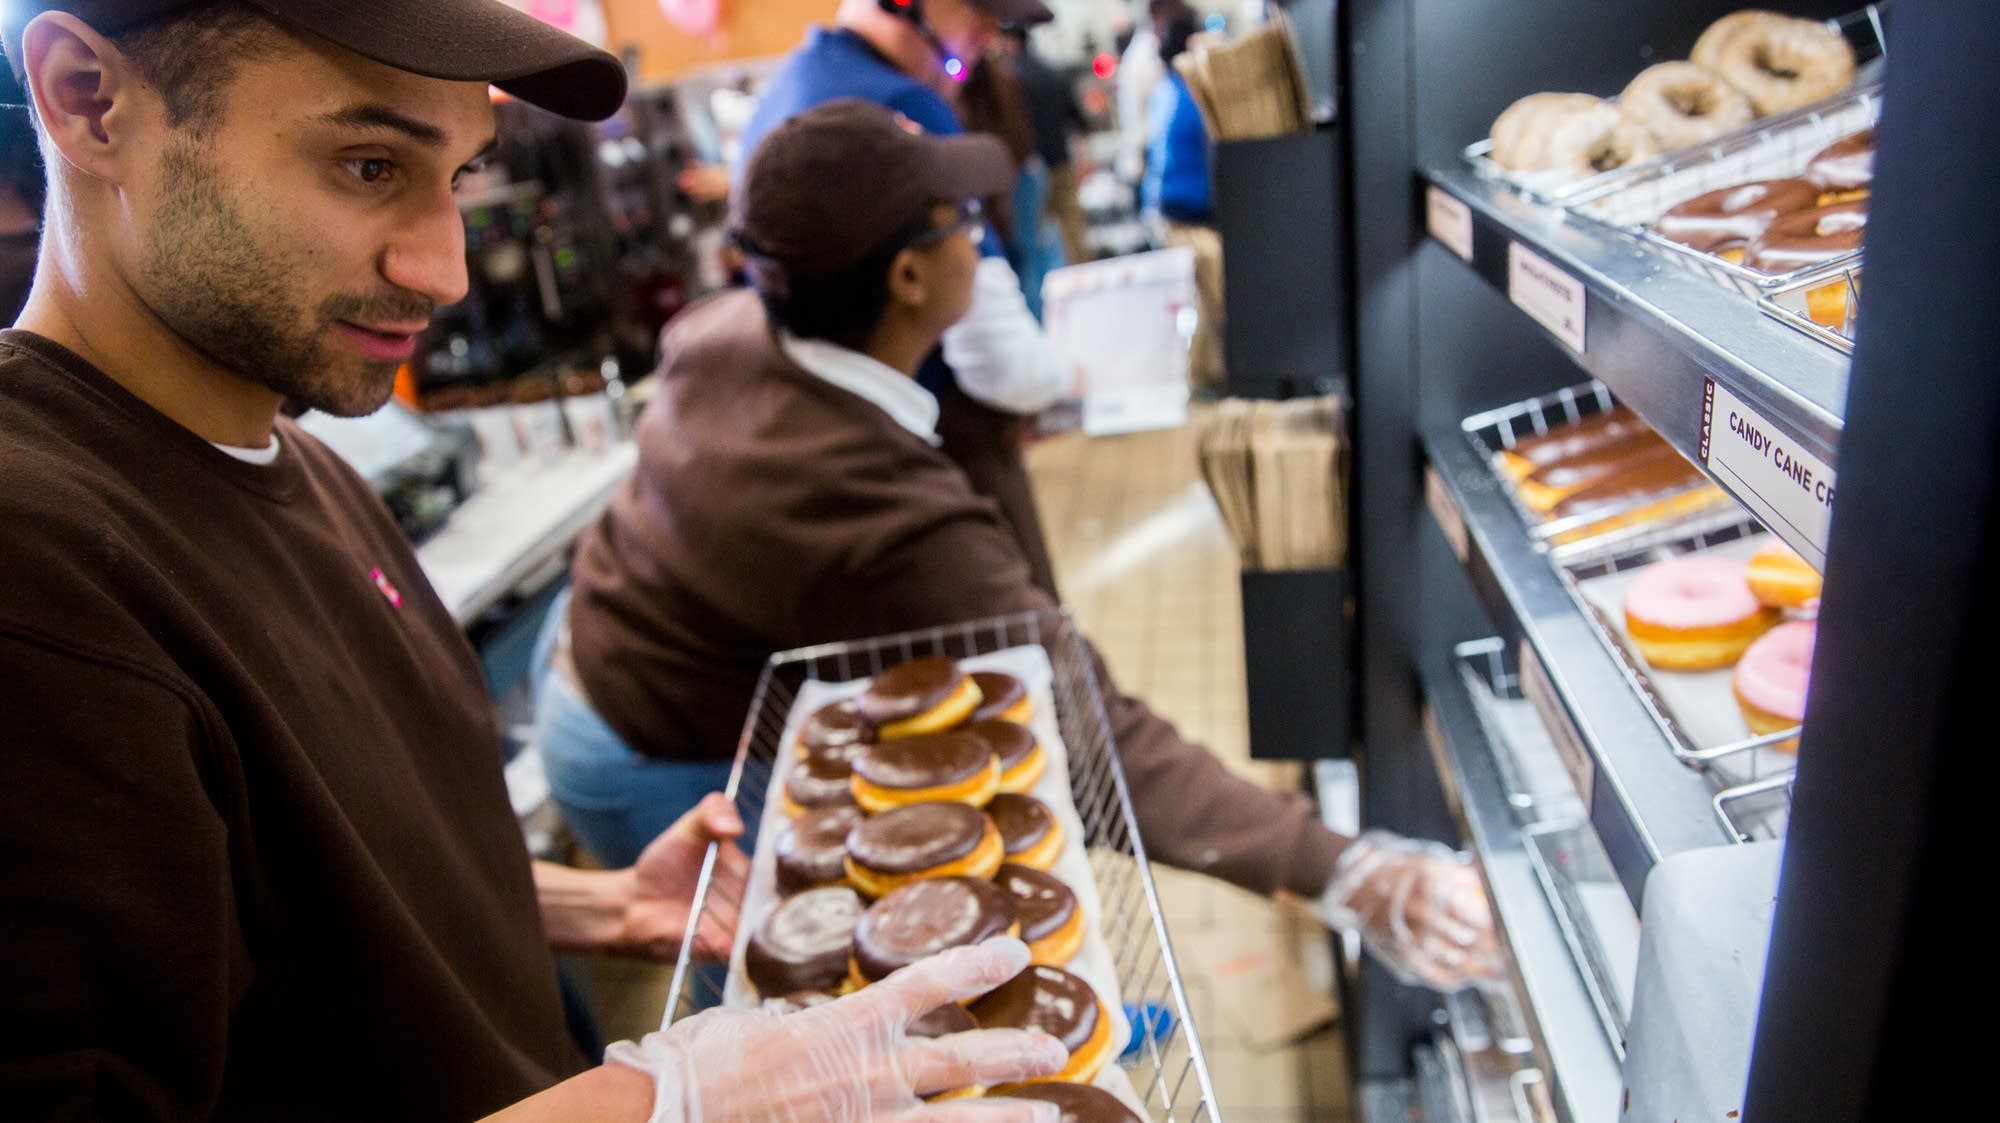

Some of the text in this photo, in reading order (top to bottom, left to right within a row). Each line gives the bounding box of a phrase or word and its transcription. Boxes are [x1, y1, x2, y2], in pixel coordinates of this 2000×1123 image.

[1701, 383, 1713, 459] CLASSIC
[1729, 411, 1772, 457] CANDY
[1774, 447, 1812, 492] CANE
